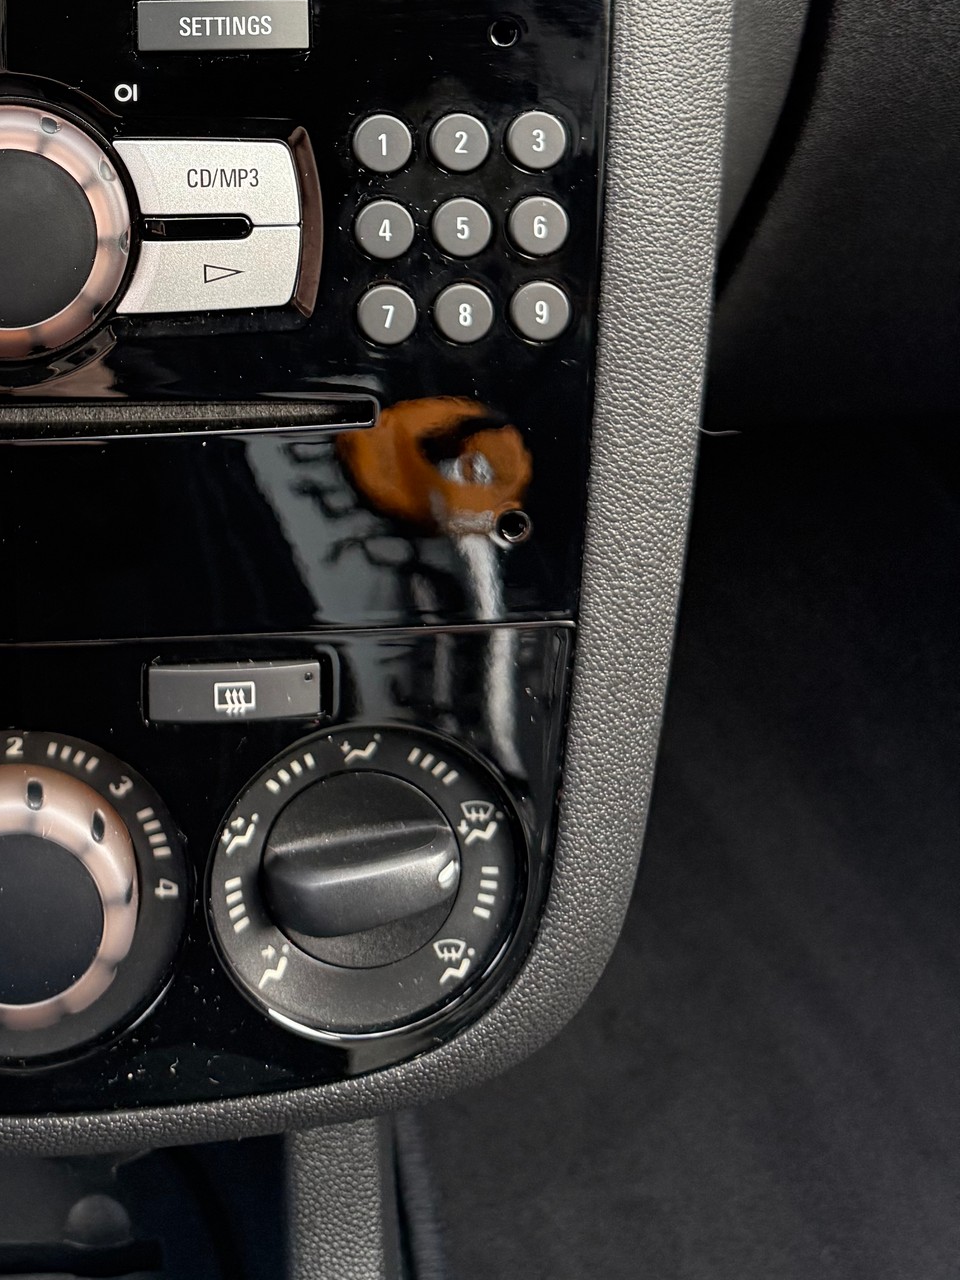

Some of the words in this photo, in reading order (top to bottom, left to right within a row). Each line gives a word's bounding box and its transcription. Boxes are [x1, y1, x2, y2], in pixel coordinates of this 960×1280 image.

[178, 15, 274, 38] SETTINGS
[377, 132, 388, 157] 1
[454, 131, 469, 155] 2
[531, 129, 546, 152] 3
[186, 167, 260, 189] CD/MP3
[378, 219, 394, 242] 4
[456, 216, 471, 240] 5
[532, 215, 548, 239] 6
[381, 305, 395, 329] 7
[458, 303, 473, 327] 8
[534, 300, 549, 324] 9
[5, 736, 24, 757] 2
[108, 775, 134, 798] 3
[153, 877, 180, 900] 4
